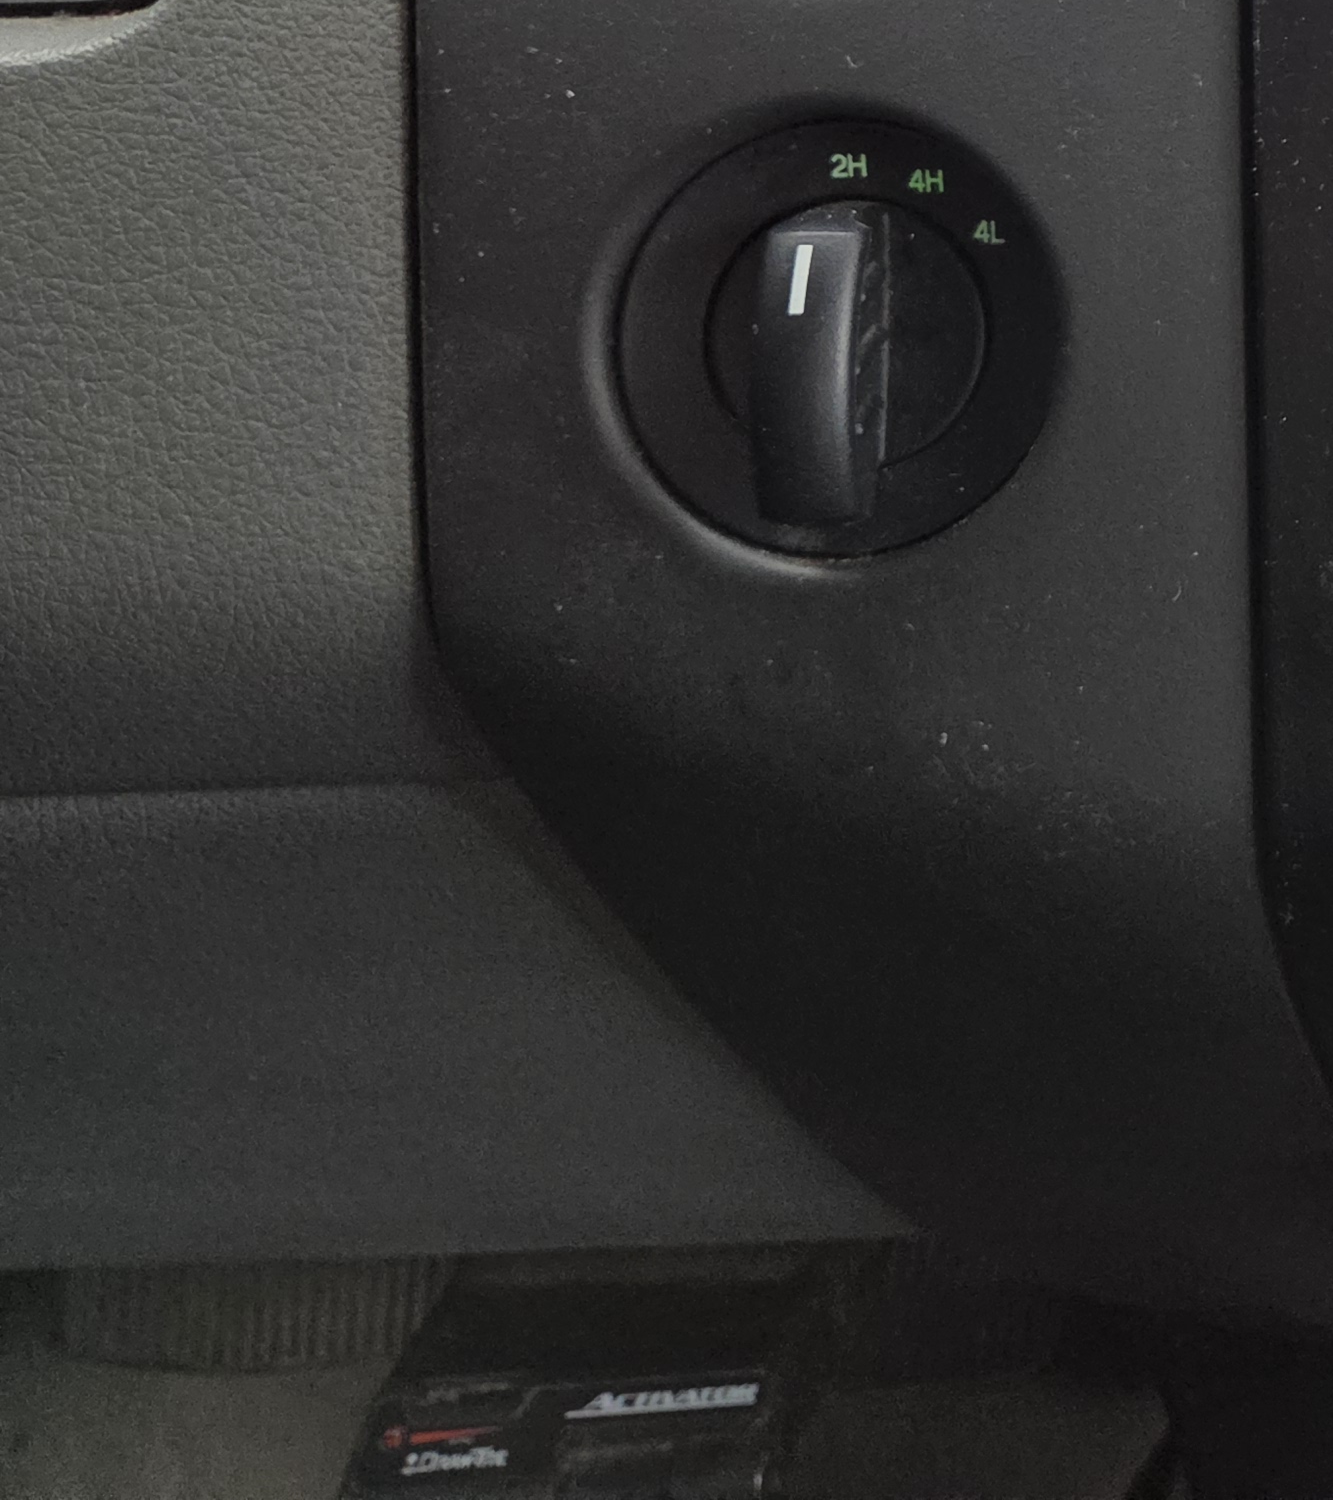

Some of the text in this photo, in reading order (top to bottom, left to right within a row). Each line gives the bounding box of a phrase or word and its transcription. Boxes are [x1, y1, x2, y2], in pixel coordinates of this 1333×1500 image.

[830, 153, 868, 179] 2H
[908, 168, 944, 193] 4H
[972, 219, 1005, 244] 4L
